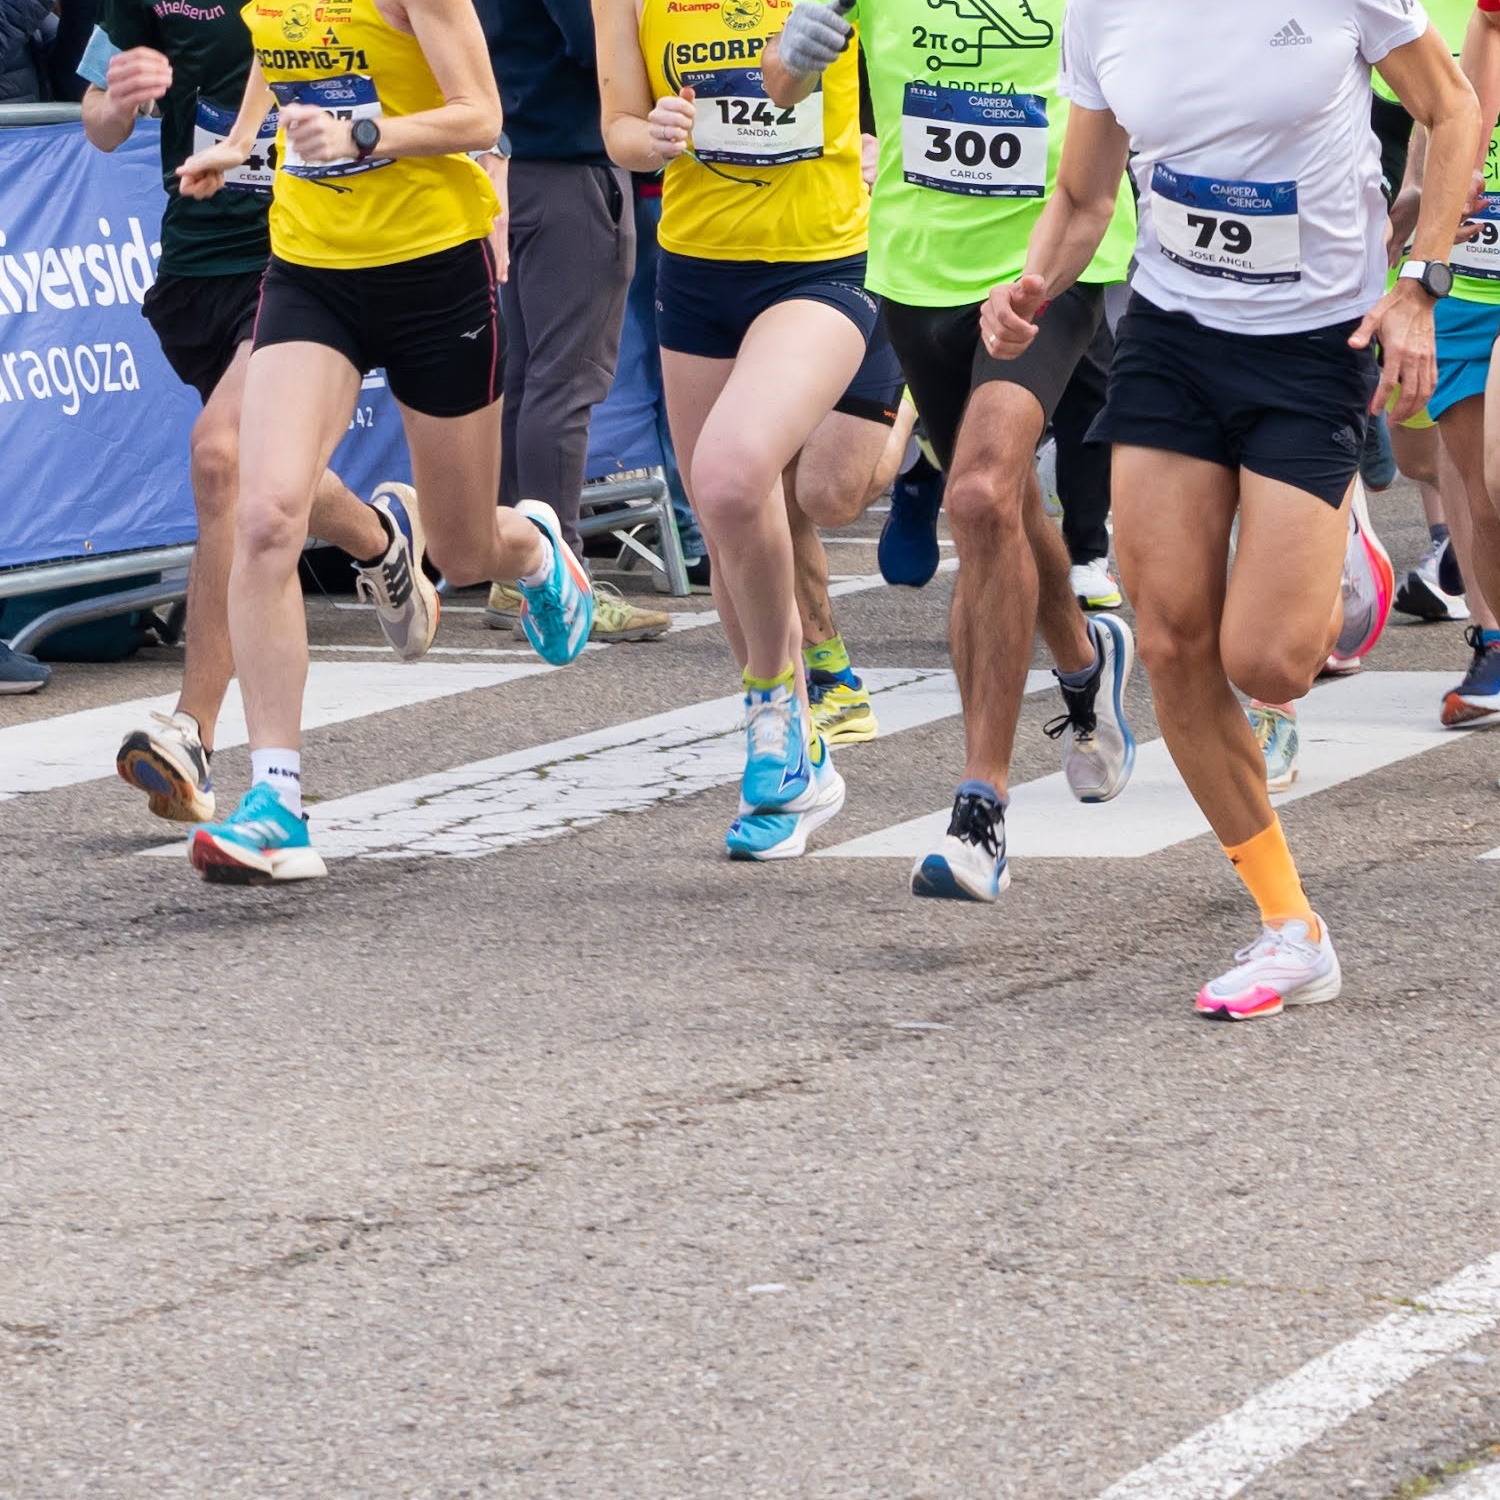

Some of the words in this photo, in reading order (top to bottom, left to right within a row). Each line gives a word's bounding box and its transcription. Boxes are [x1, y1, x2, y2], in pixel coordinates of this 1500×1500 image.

[1270, 36, 1313, 47] adidas
[677, 38, 769, 65] SCORP
[257, 49, 370, 71] SCORPIO-71
[968, 96, 1014, 109] CARRERA
[716, 100, 797, 127] 1242
[982, 108, 1026, 120] CIENCIA
[737, 127, 778, 138] SANDRA
[924, 125, 1022, 169] 300
[950, 169, 993, 181] CARLOS
[1210, 184, 1258, 198] CARRERA
[1227, 196, 1273, 209] CIENCIA
[1187, 212, 1252, 255] 79
[0, 217, 162, 315] iversid
